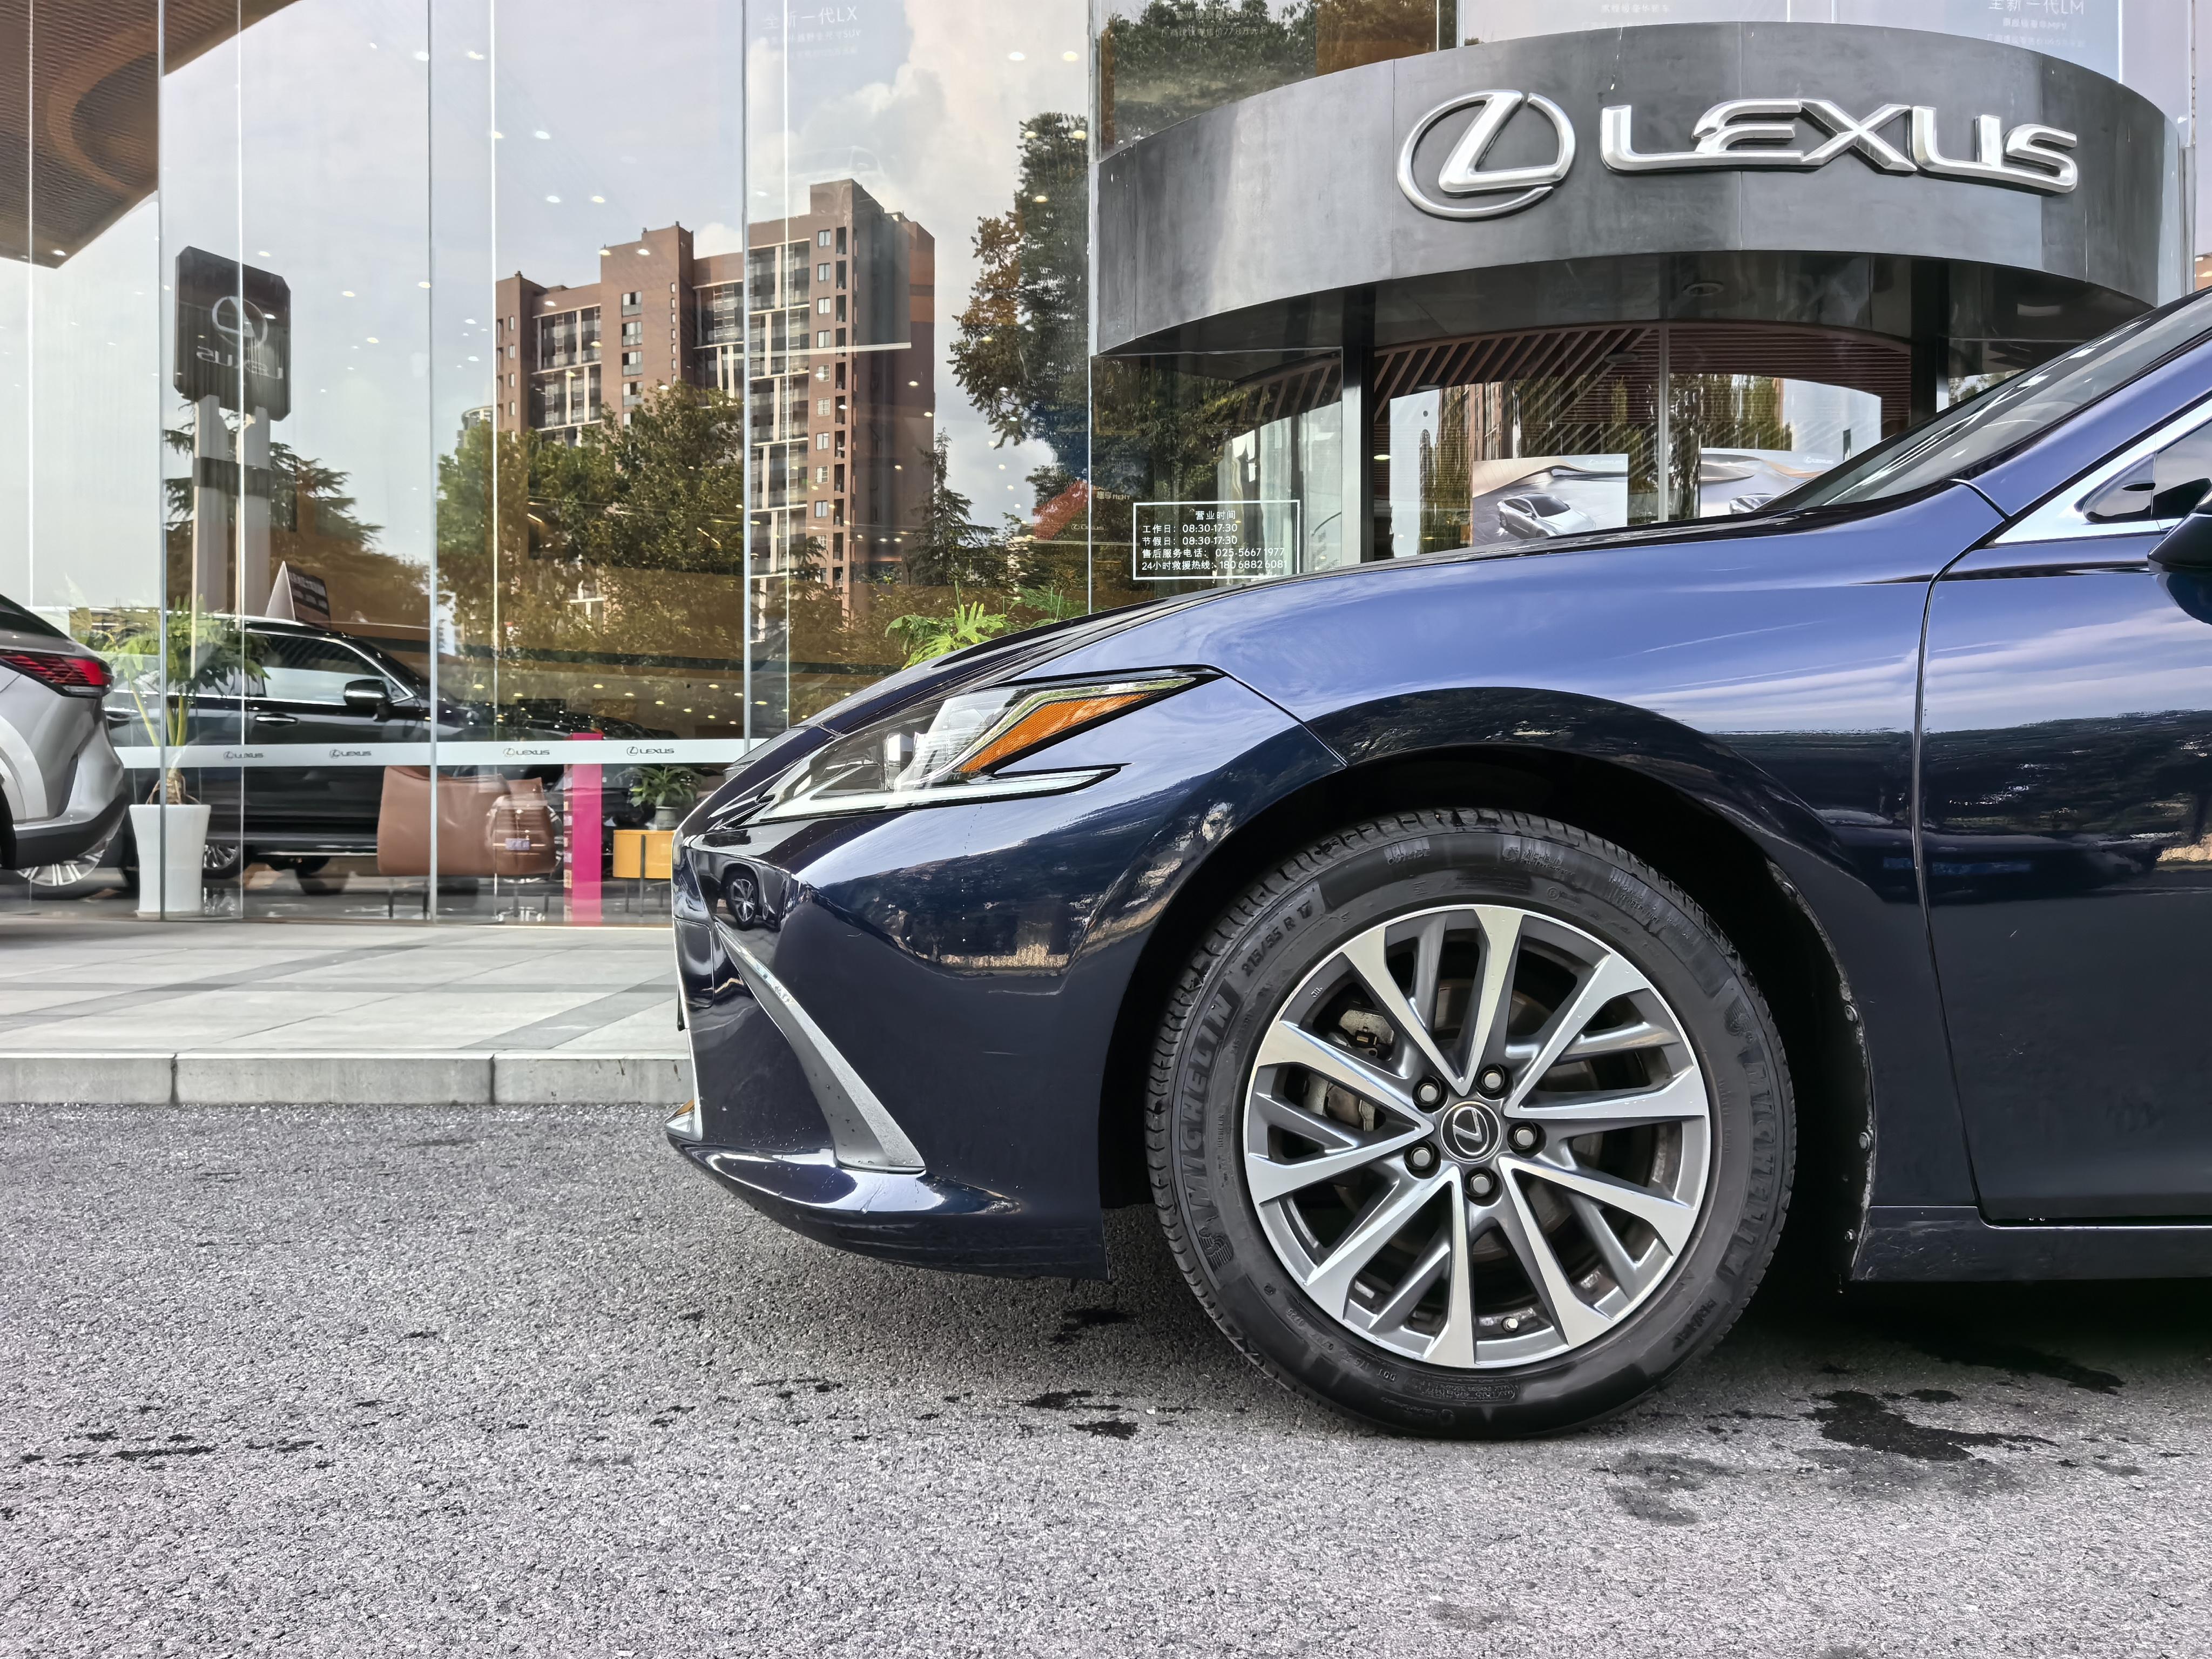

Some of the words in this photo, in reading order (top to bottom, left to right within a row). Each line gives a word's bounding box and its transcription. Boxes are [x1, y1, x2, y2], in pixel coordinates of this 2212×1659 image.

[1600, 98, 2078, 194] LEXUS
[1182, 524, 1238, 533] 08:30-17:30
[1195, 510, 1236, 521] 营业时间
[1182, 536, 1238, 545] 08:30-17:30
[1242, 926, 1284, 977] 215/55
[1283, 916, 1296, 932] R
[1182, 993, 1232, 1208] MICHELIN
